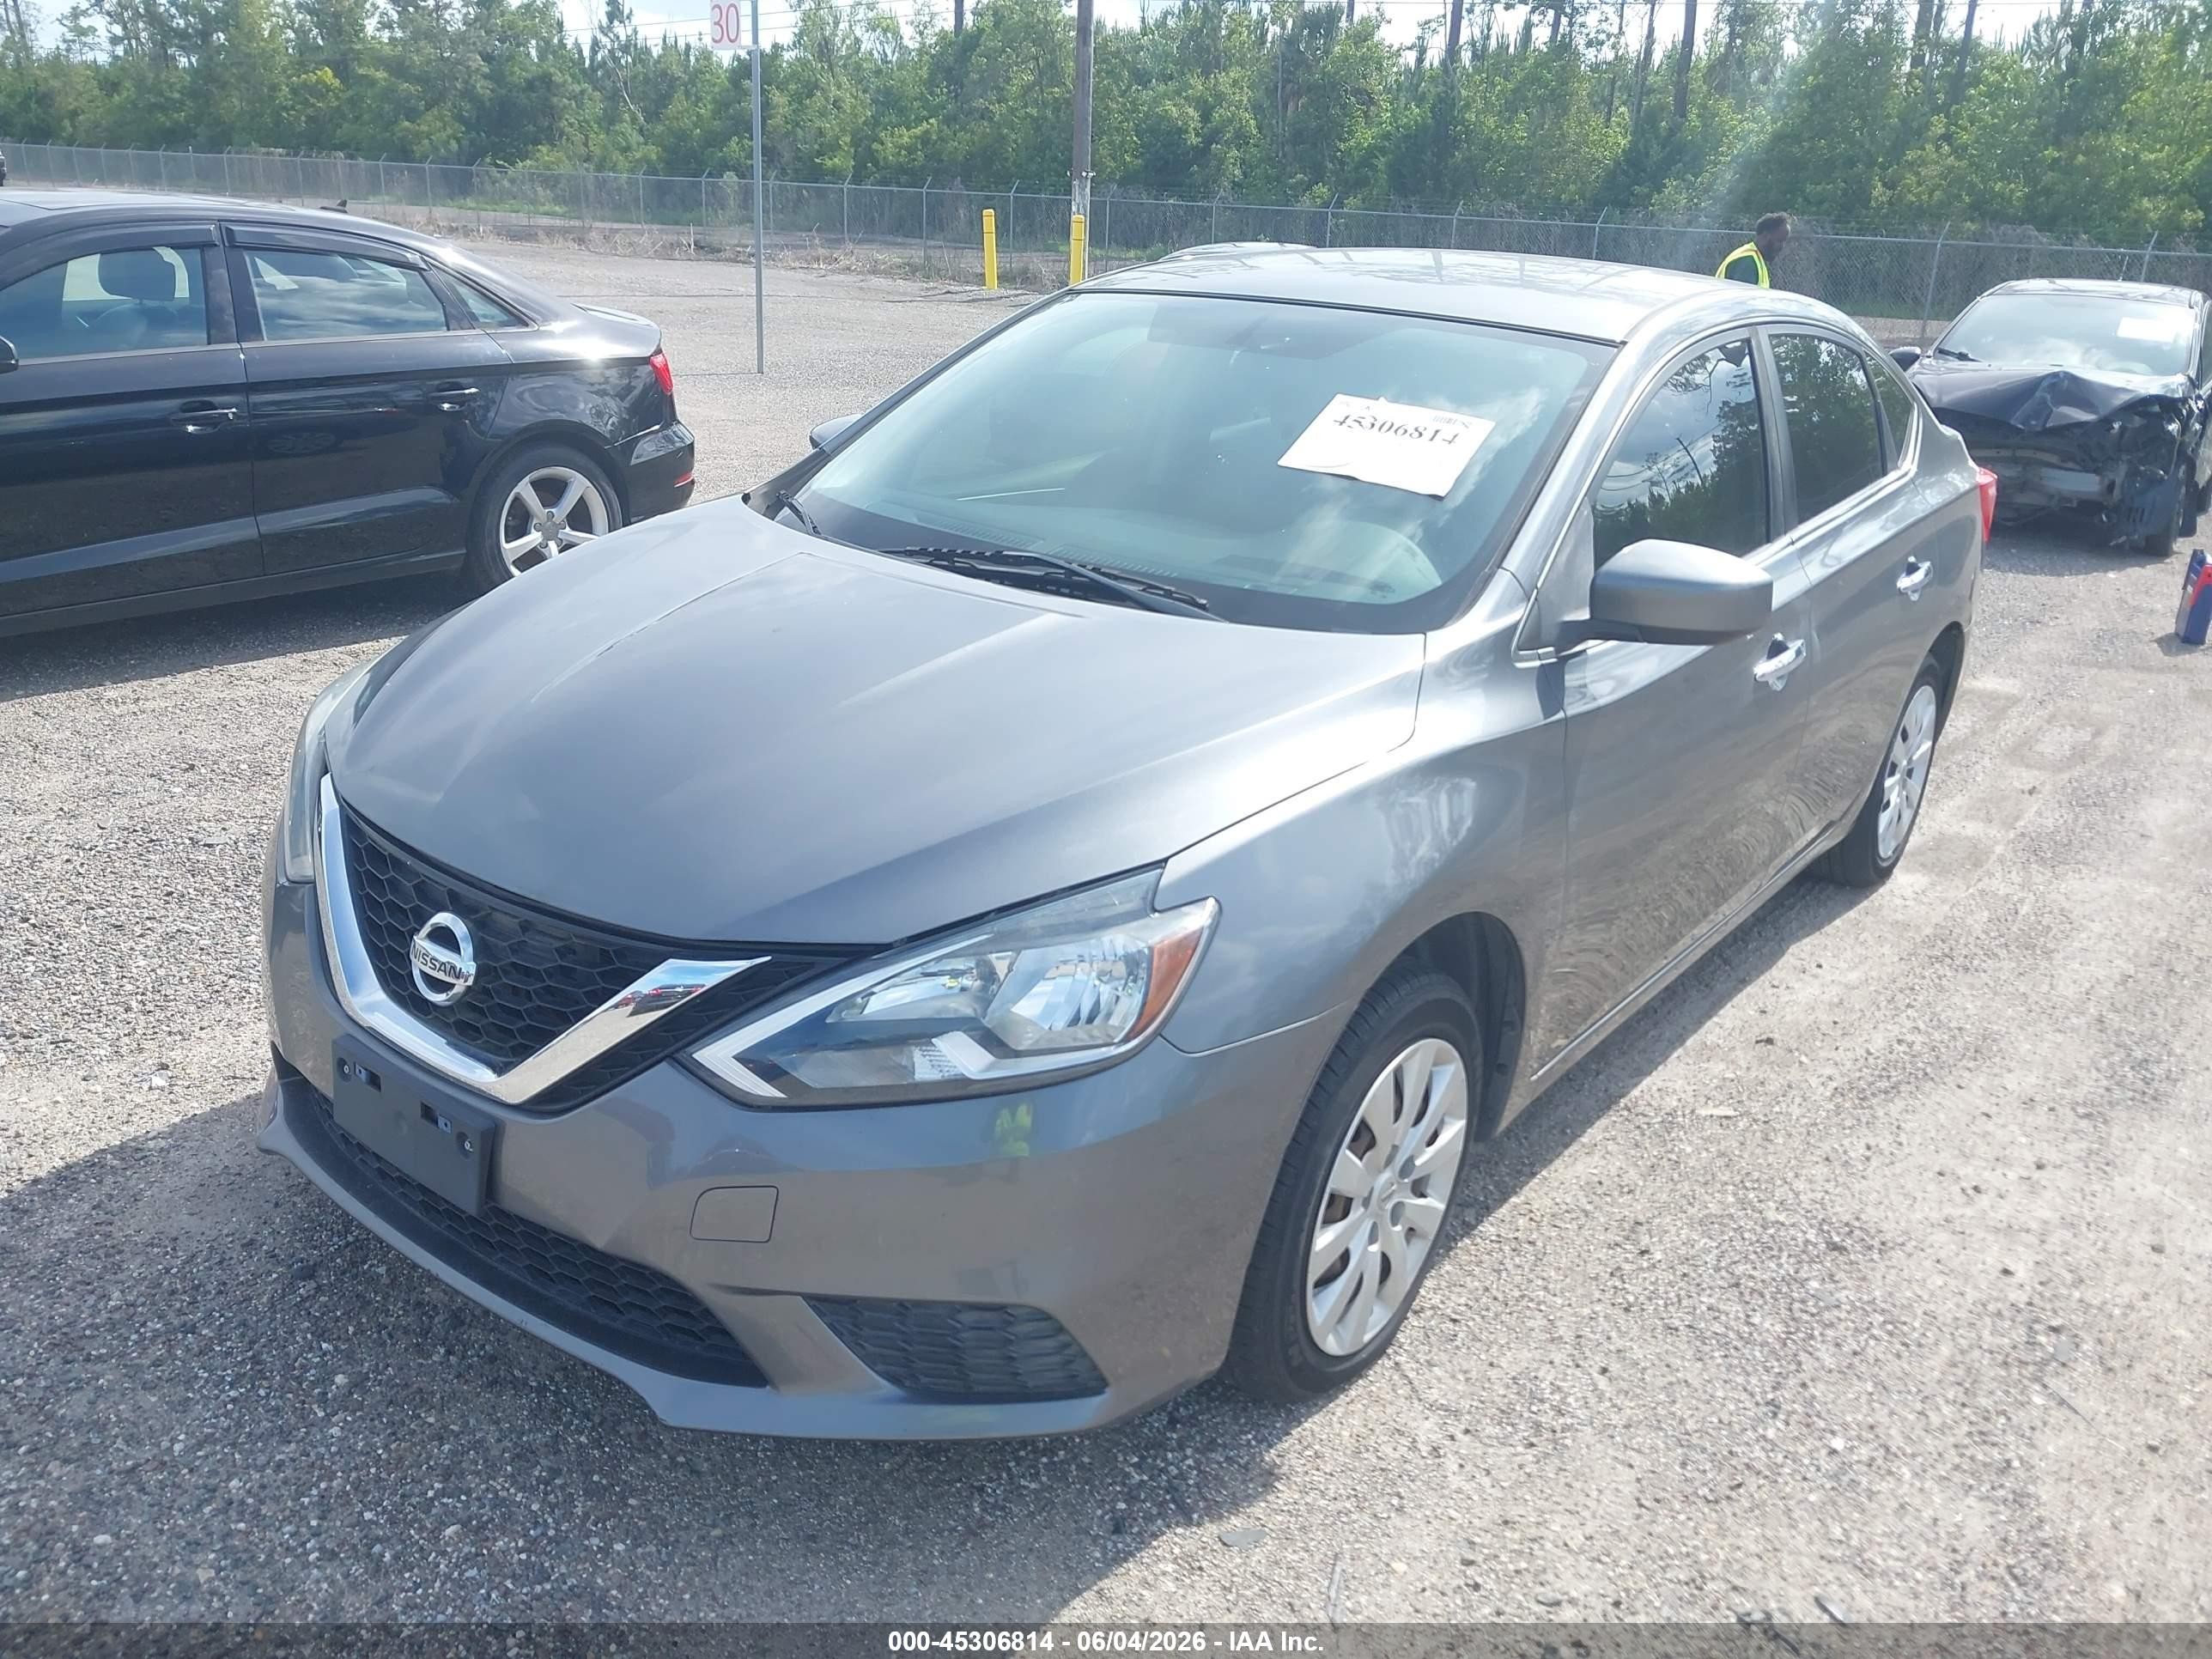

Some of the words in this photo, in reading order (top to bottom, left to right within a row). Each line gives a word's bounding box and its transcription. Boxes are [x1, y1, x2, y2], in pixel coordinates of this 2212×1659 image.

[711, 3, 739, 43] 30
[1334, 414, 1460, 444] 45306814
[412, 943, 462, 980] NISSAN
